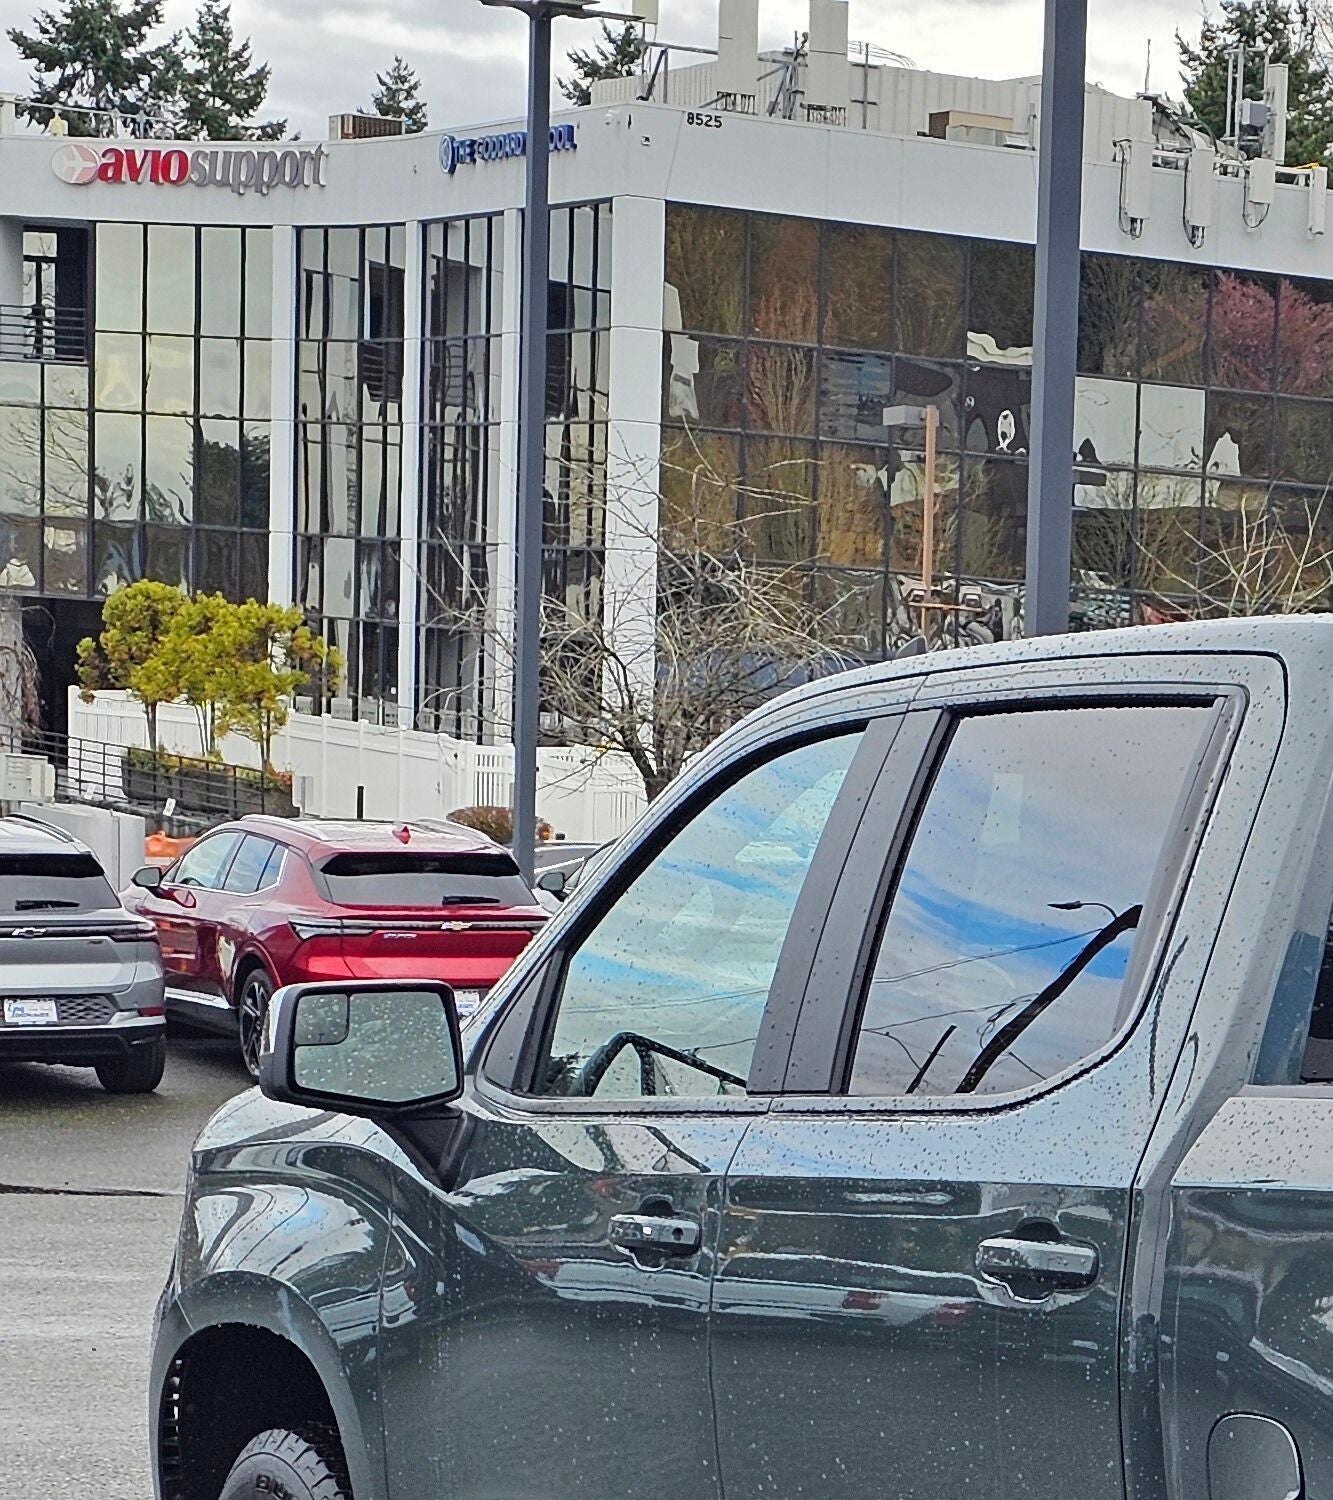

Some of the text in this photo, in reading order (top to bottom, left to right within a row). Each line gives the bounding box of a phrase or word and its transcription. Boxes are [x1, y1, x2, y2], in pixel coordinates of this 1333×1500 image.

[687, 111, 722, 128] 8525
[454, 138, 477, 164] THE
[476, 131, 527, 160] GODDARD
